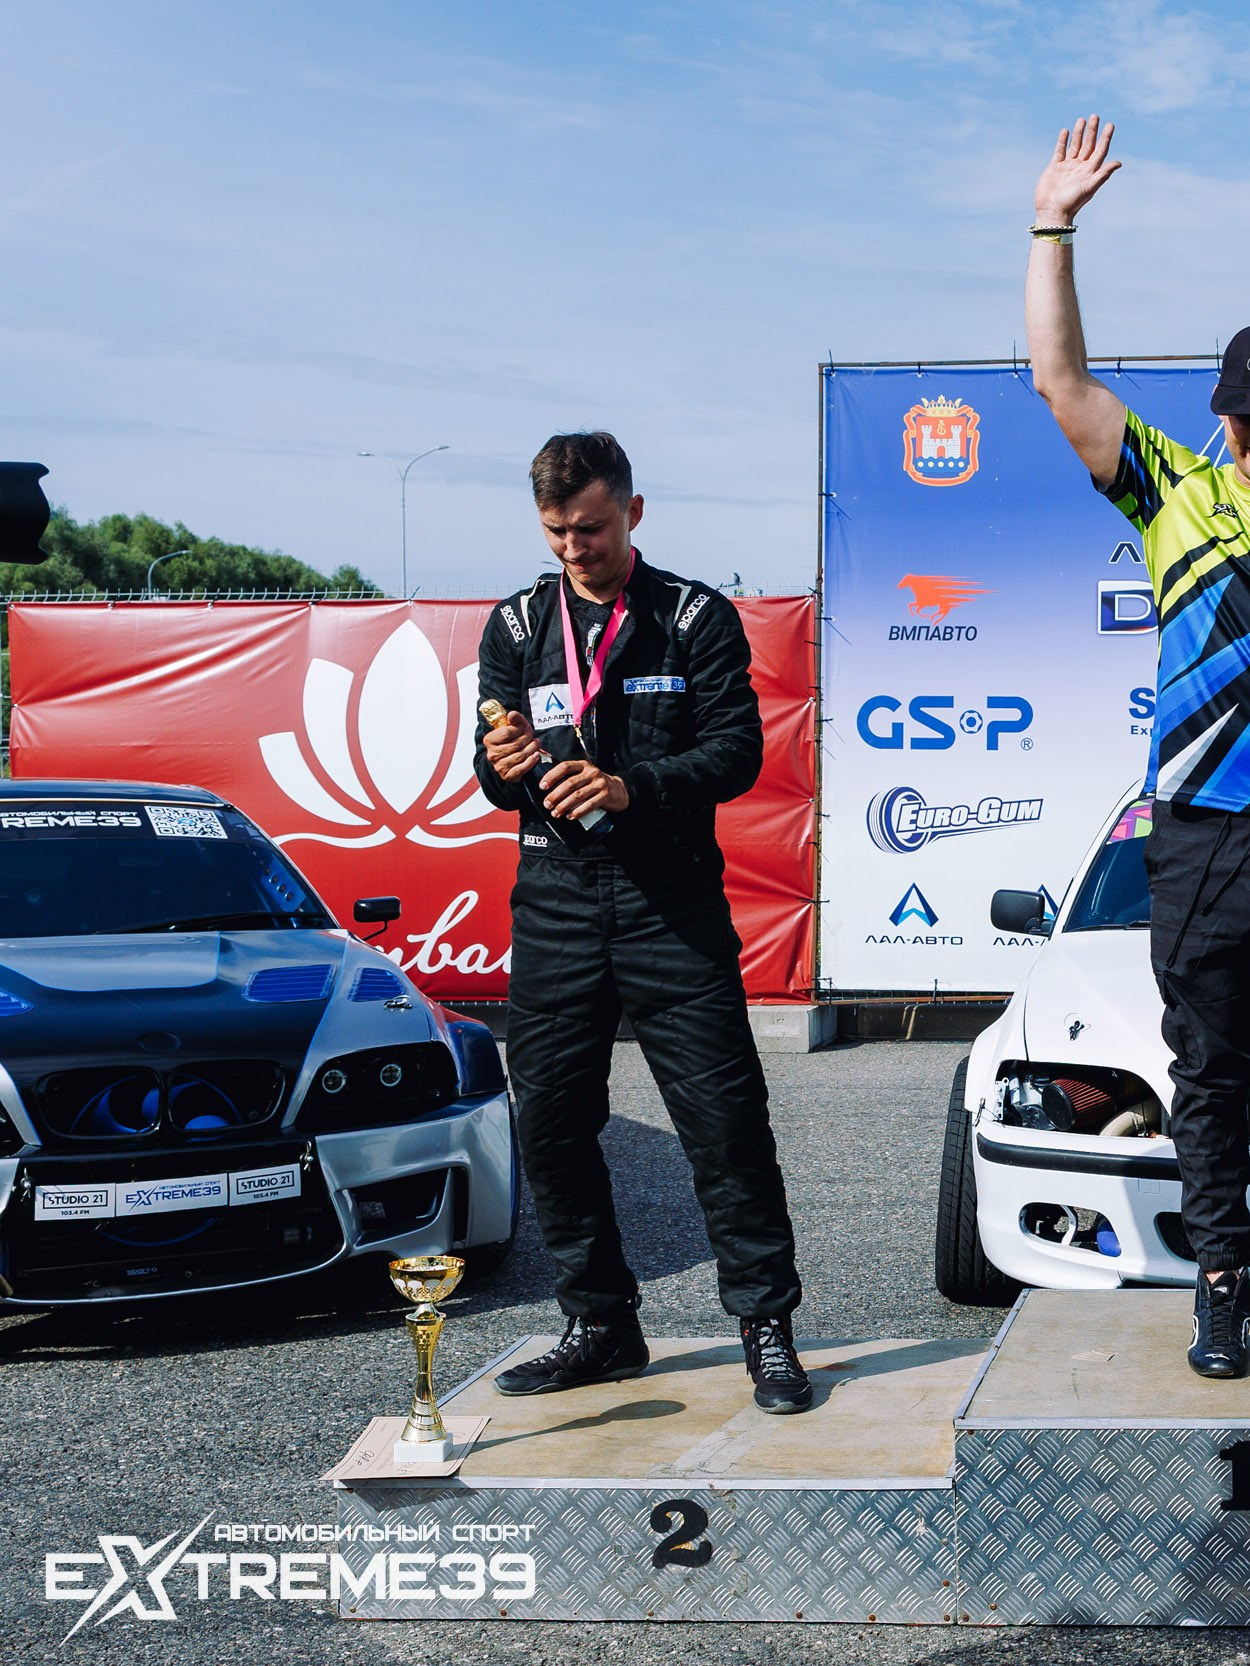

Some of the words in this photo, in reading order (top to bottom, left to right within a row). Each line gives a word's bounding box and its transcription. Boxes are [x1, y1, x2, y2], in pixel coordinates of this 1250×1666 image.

[677, 593, 711, 632] sparco
[500, 604, 526, 643] sparco
[888, 625, 978, 642] ВМПАВТО
[100, 810, 138, 818] СПОРТ
[523, 833, 549, 847] parco
[241, 1177, 279, 1190] STUDIO
[280, 1175, 291, 1185] 21
[48, 1195, 90, 1205] STUDIO
[93, 1194, 104, 1203] 21
[125, 1184, 222, 1212] EXTREME39
[650, 1499, 713, 1570] 2
